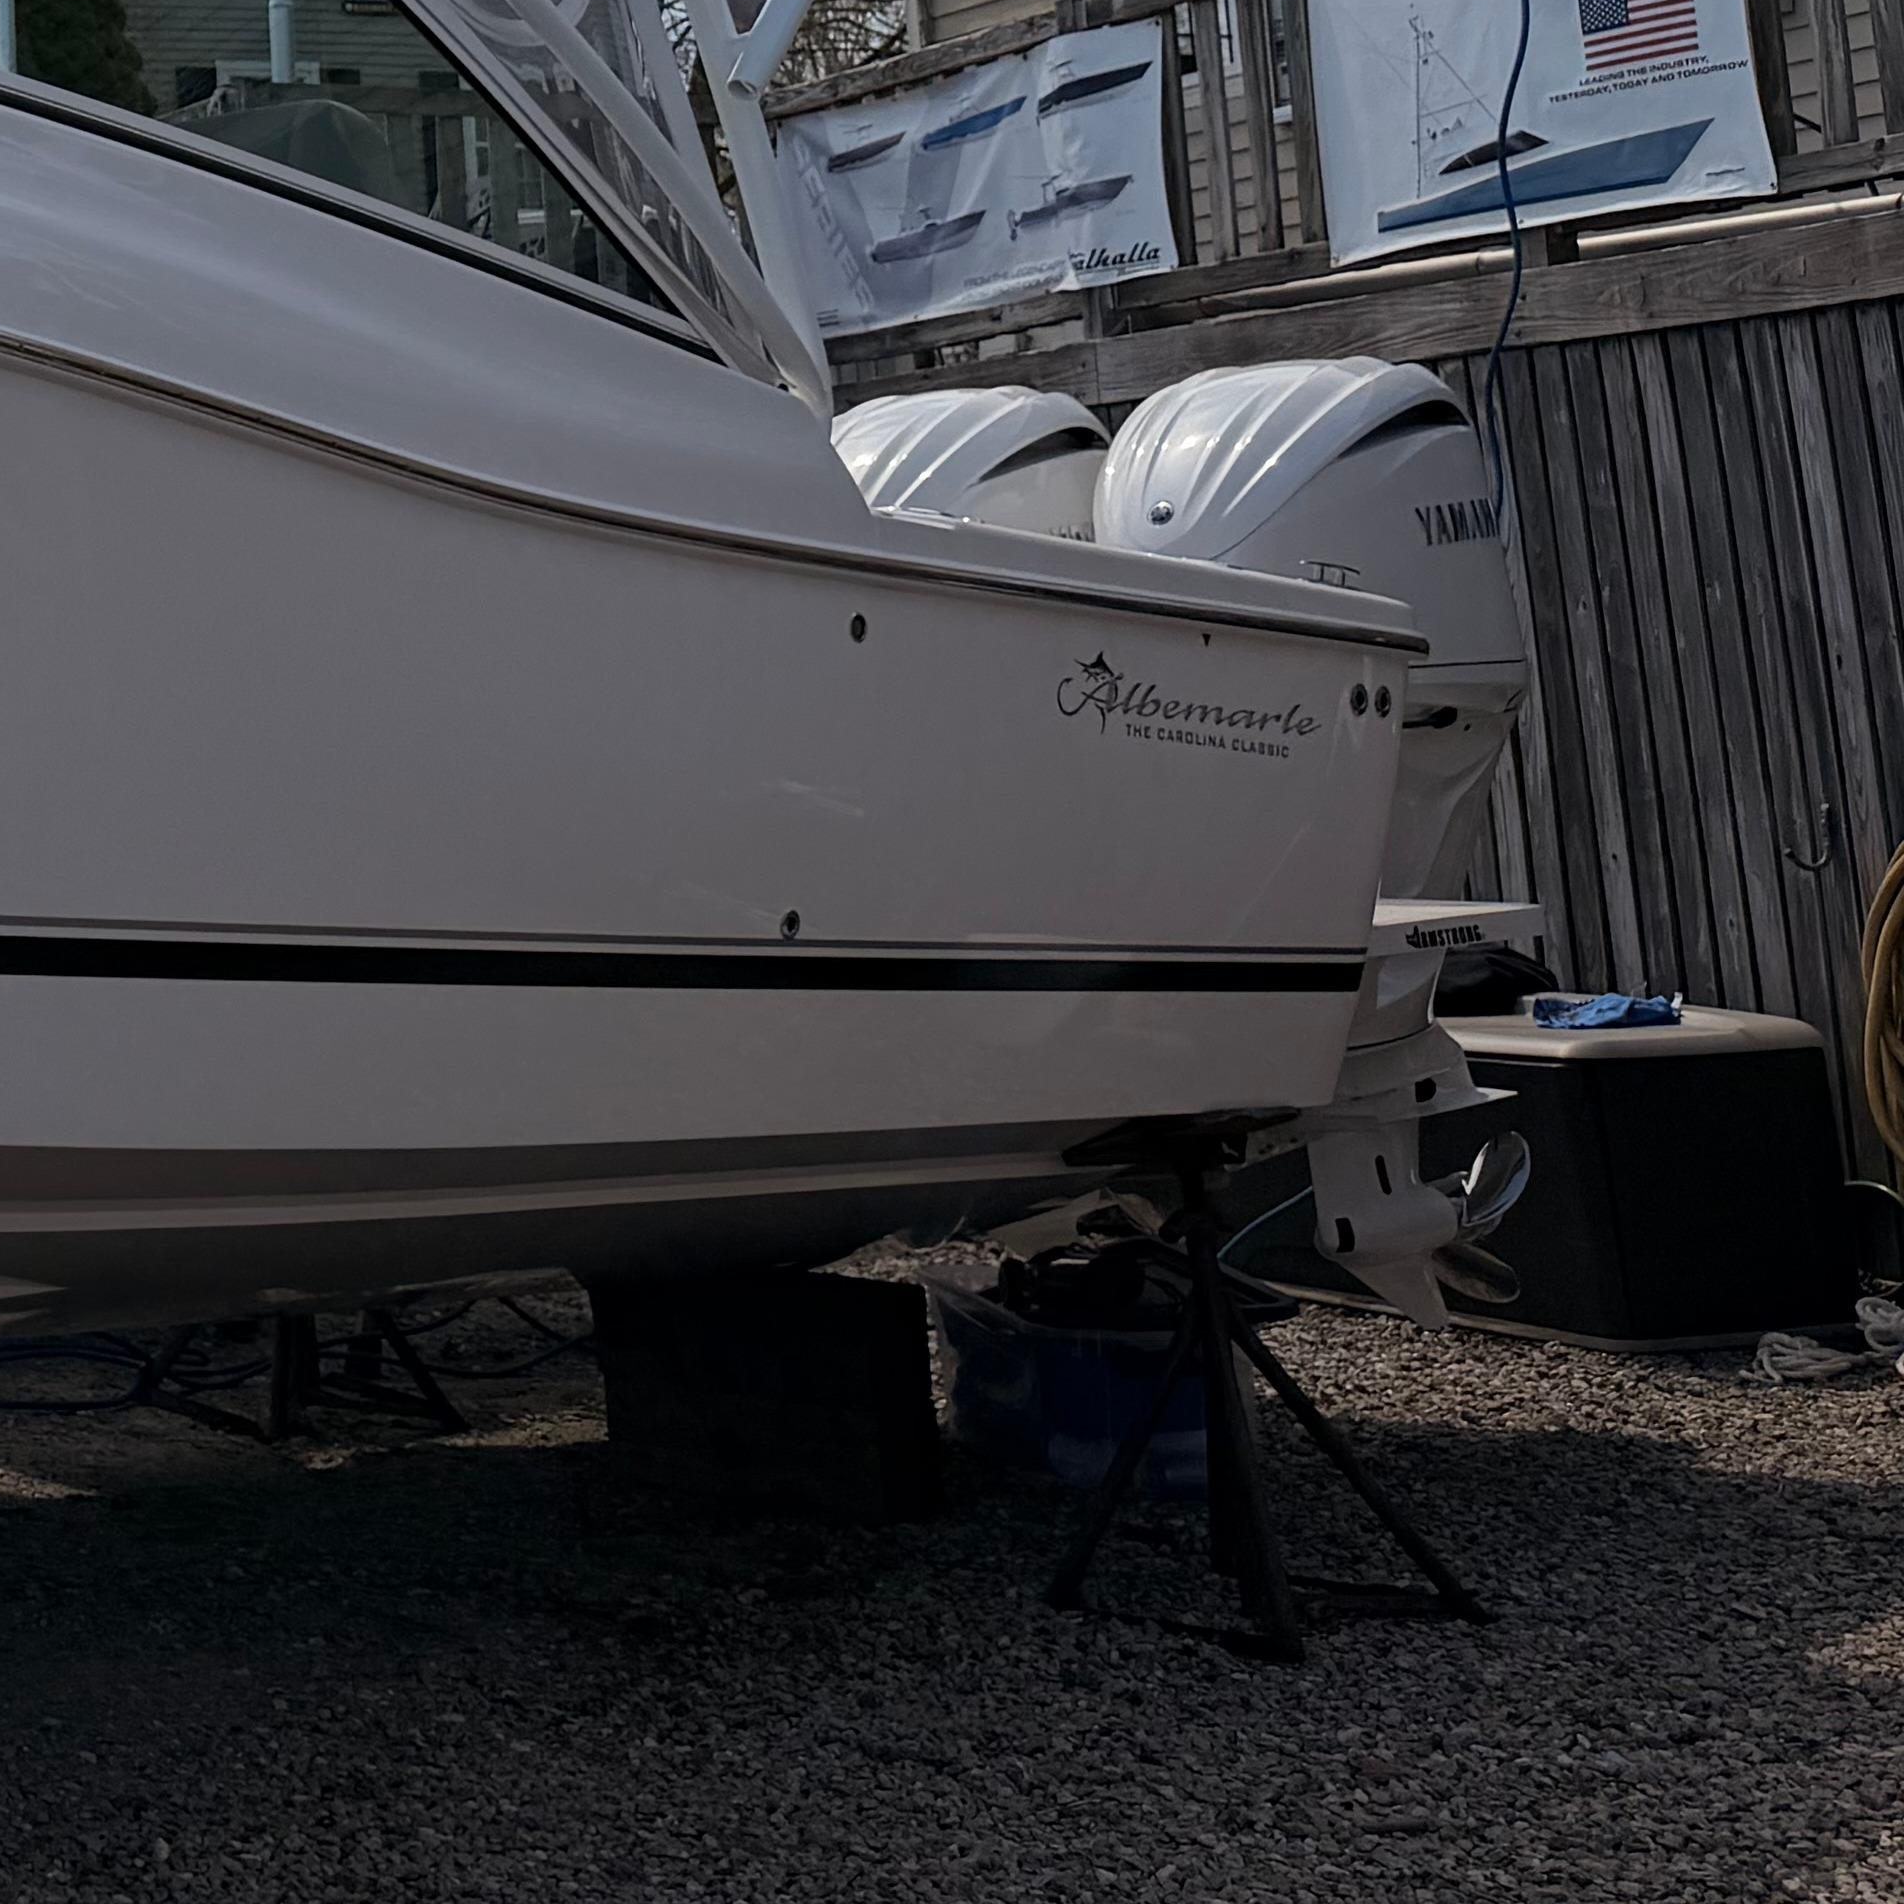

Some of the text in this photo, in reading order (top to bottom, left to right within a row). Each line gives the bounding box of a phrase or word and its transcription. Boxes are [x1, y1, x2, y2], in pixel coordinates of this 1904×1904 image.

[1579, 70, 1625, 86] LEADING
[1627, 66, 1647, 78] THE
[1613, 77, 1648, 92] TODAY
[1651, 73, 1675, 85] AND
[1678, 59, 1749, 81] TOMORROW
[1057, 673, 1323, 737] Albemarle
[1126, 723, 1290, 759] THE CAROLINA CLASSIC
